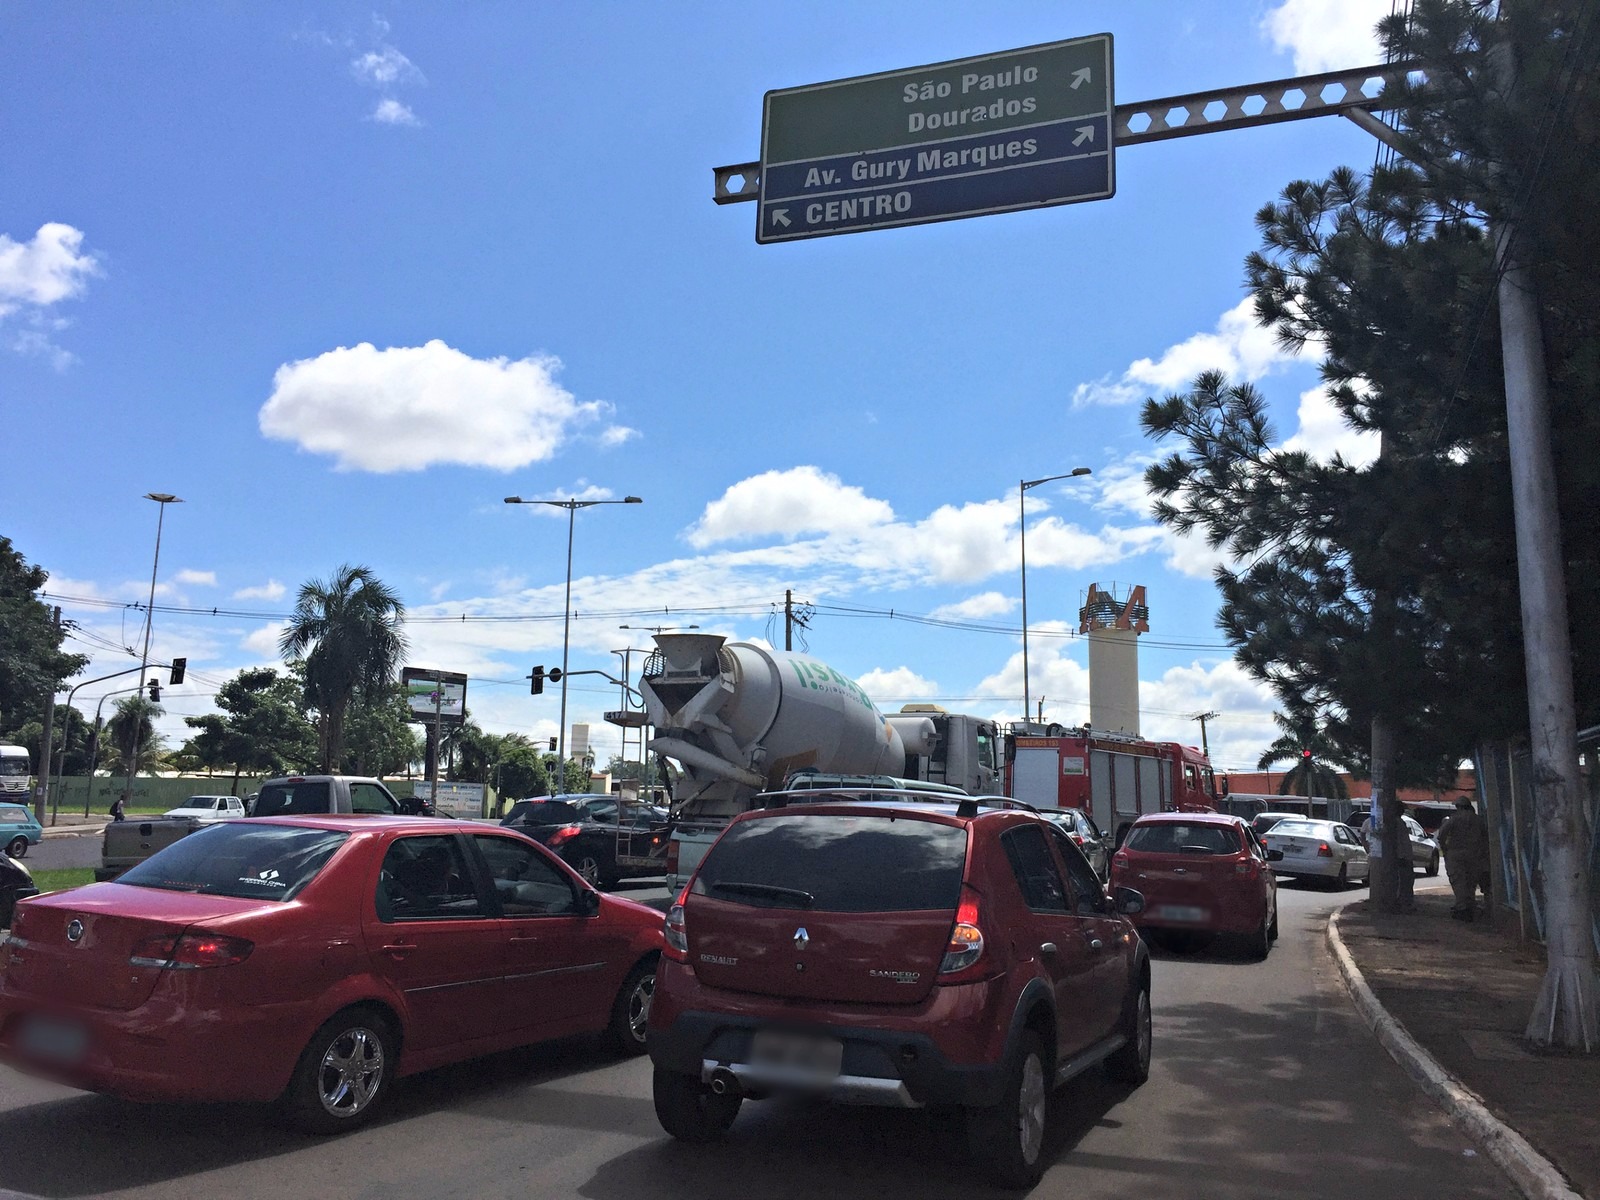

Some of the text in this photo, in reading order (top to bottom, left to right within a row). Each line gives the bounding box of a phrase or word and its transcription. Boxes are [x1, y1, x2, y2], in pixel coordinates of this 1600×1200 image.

[903, 65, 1039, 103] São Paulo
[908, 97, 1037, 133] Dourados
[804, 138, 1038, 188] Av. Gury Marques
[806, 191, 912, 224] CENTRO
[606, 711, 622, 719] 417
[700, 953, 739, 966] RENAULT
[869, 969, 921, 979] SANDERO
